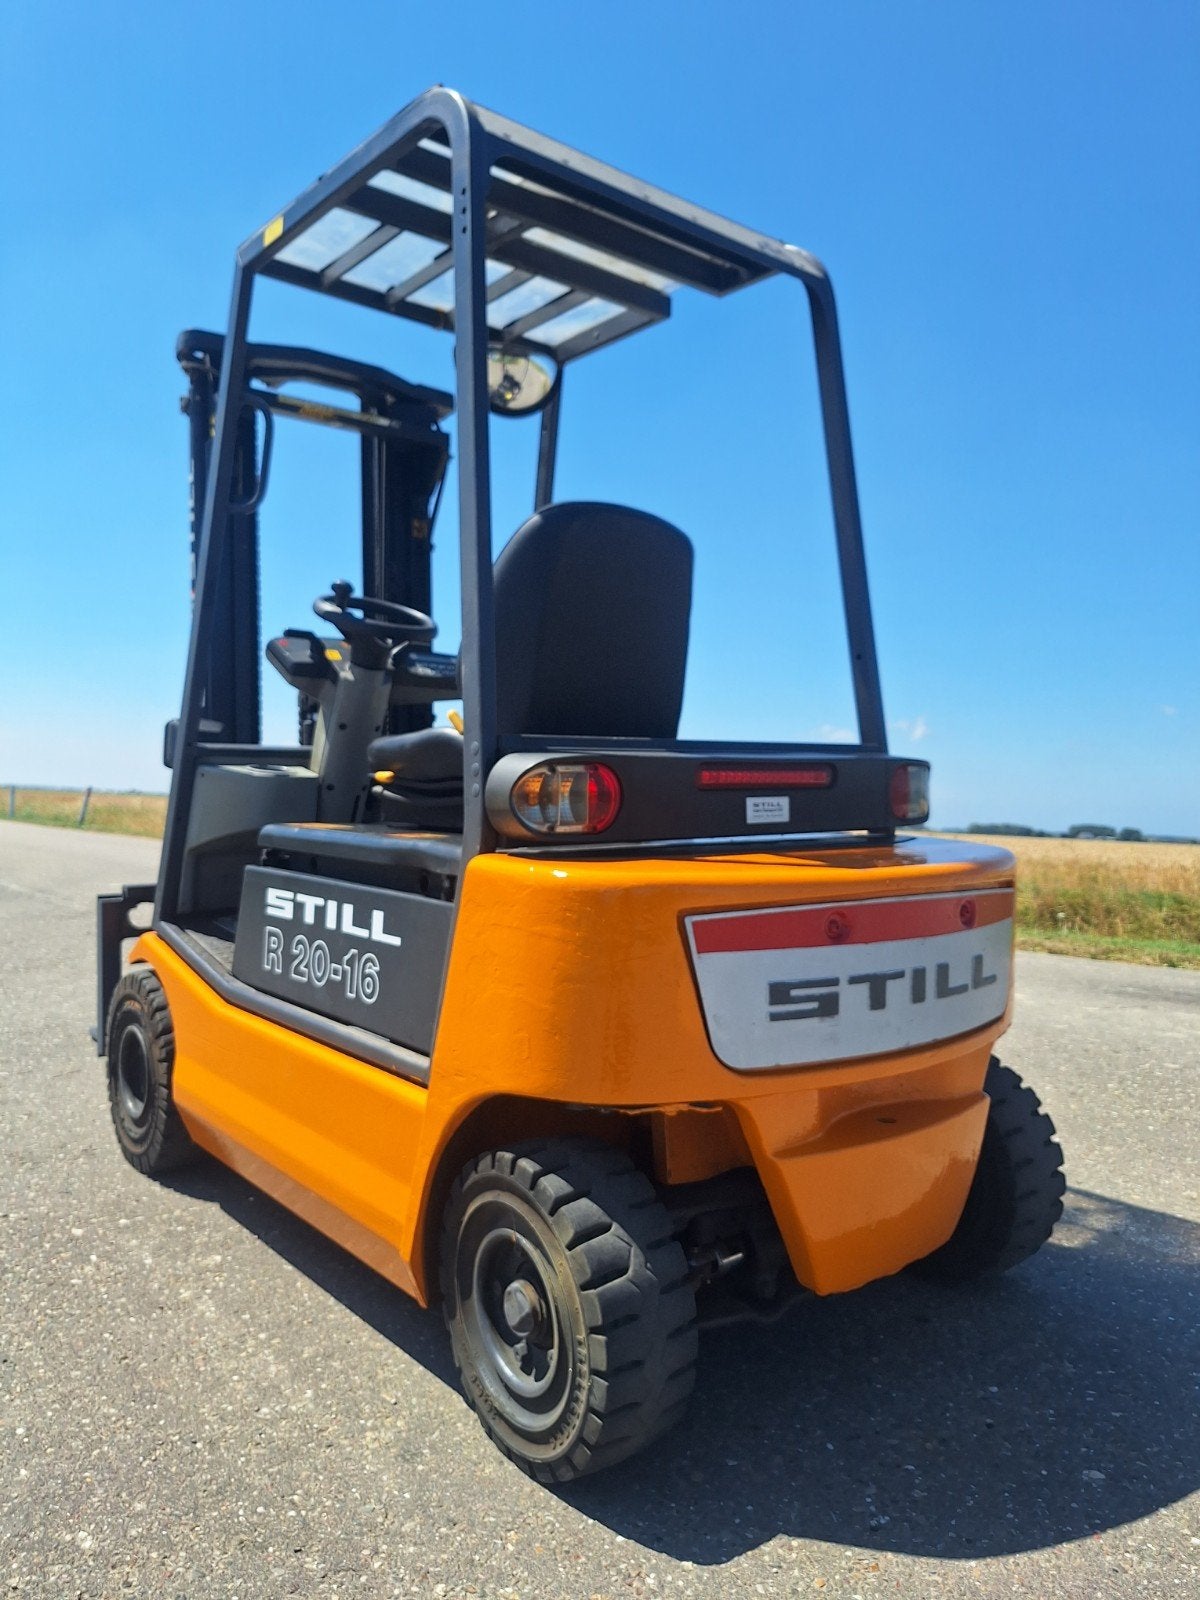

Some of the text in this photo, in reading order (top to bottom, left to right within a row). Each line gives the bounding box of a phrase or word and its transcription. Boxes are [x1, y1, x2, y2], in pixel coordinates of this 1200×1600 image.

[265, 887, 401, 946] STILL
[264, 926, 380, 1005] R 20-16
[768, 954, 997, 1022] STILL
